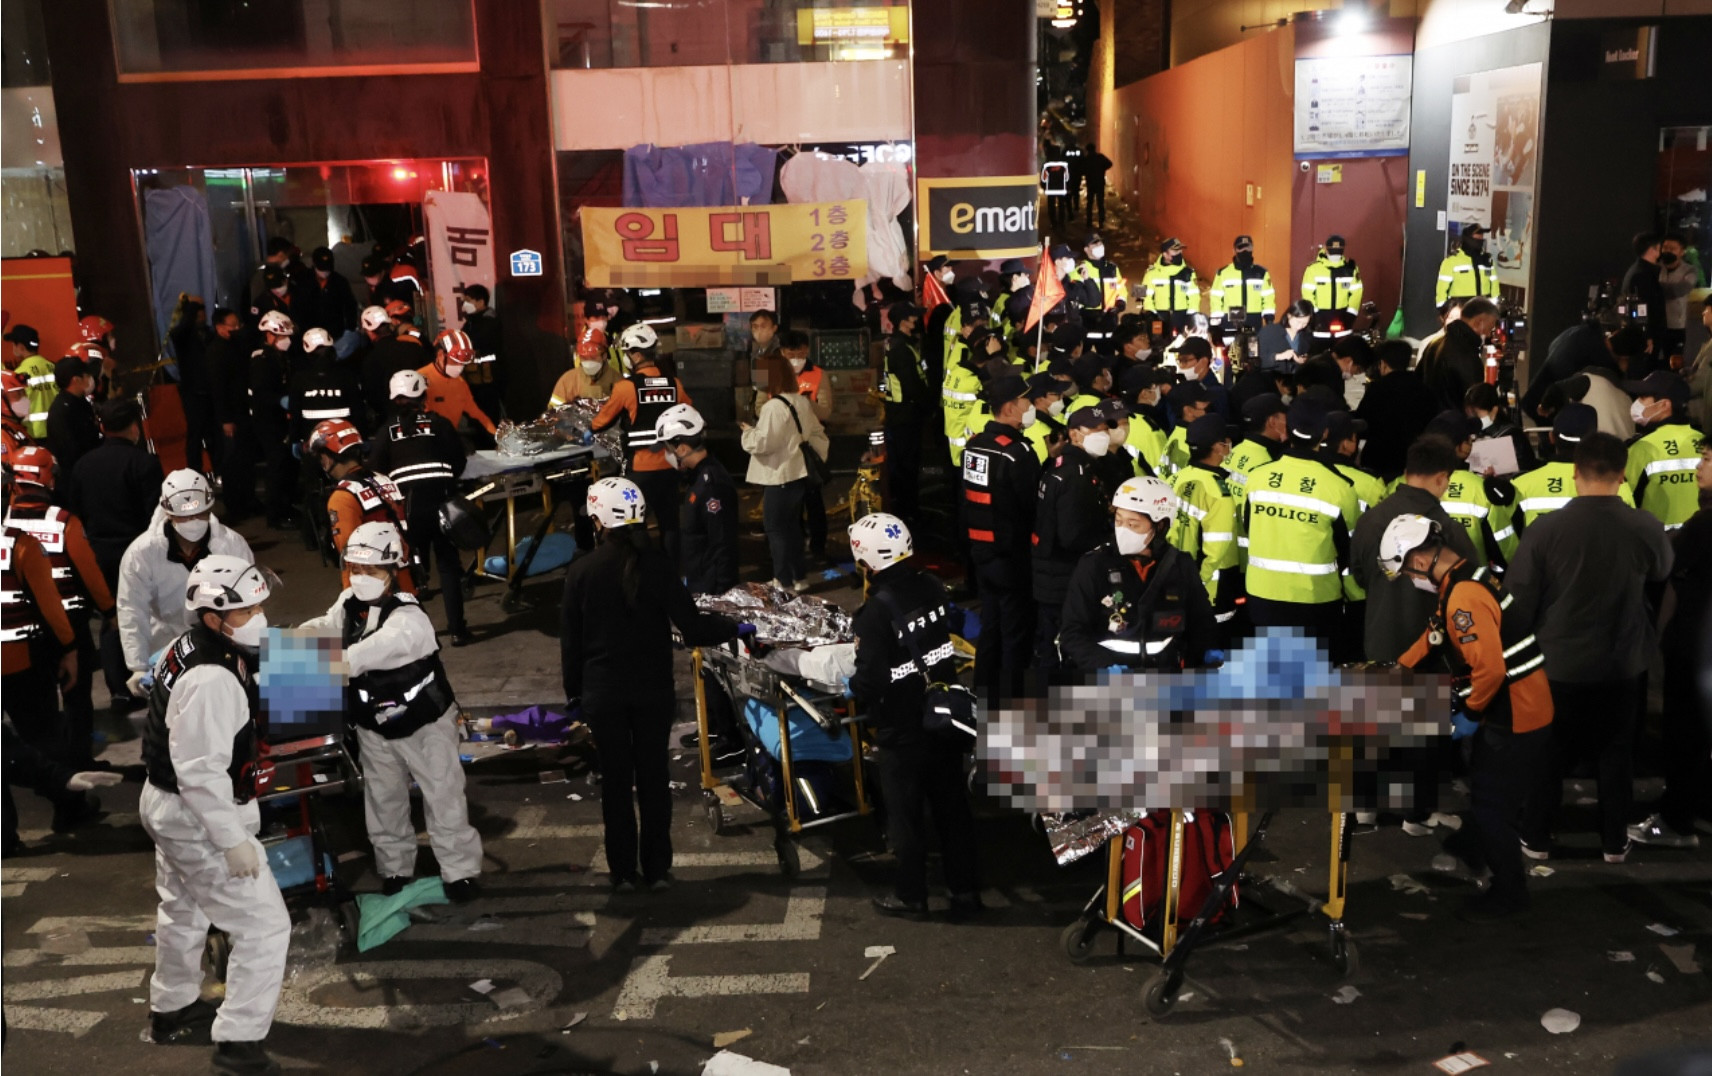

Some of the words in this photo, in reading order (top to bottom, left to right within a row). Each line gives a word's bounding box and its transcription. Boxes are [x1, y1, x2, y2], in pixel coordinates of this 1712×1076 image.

[1451, 163, 1460, 177] ON
[1461, 163, 1471, 177] THE
[1472, 163, 1490, 177] SCENE
[1451, 179, 1470, 195] SINCE
[1471, 179, 1489, 197] 1974
[809, 206, 847, 226] 1층
[810, 230, 849, 251] 2층
[518, 261, 536, 273] 173
[812, 256, 850, 277] 3층
[1659, 473, 1694, 486] POLI
[1254, 504, 1319, 524] POLICE
